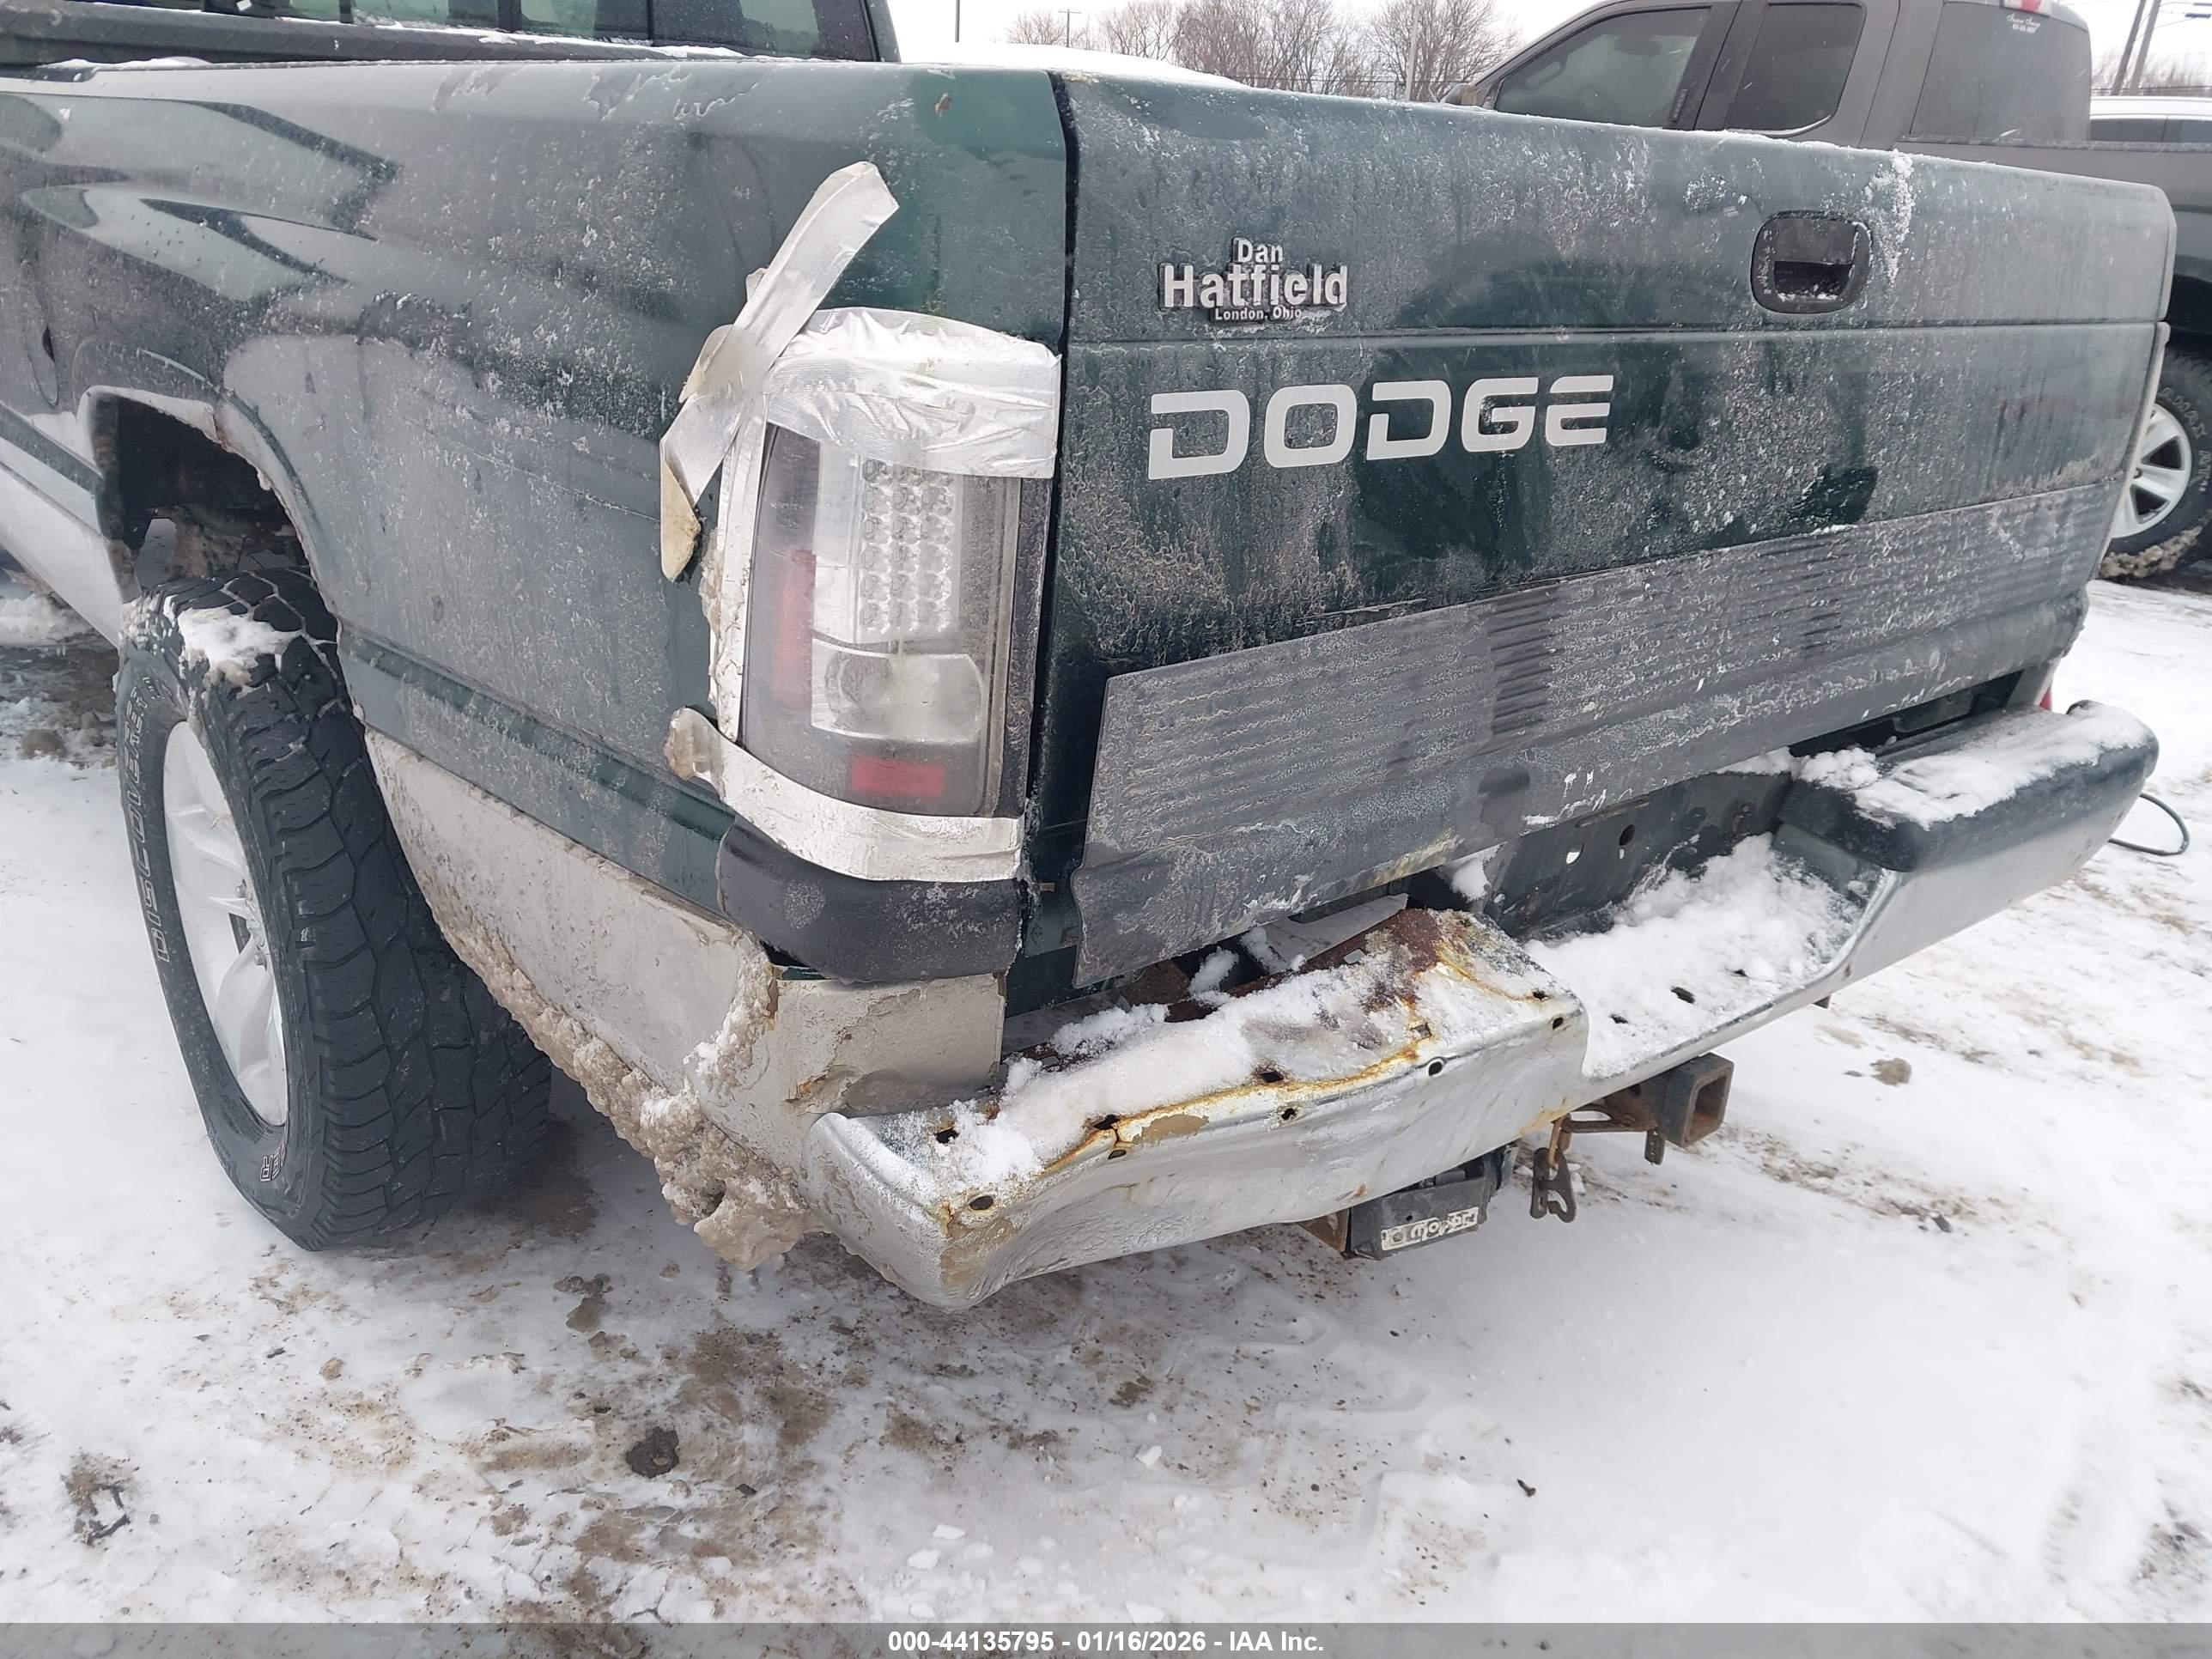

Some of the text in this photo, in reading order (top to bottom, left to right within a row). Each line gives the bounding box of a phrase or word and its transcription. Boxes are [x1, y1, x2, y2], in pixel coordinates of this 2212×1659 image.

[1162, 263, 1348, 307] Hatfield
[1235, 237, 1284, 263] Dan
[1147, 374, 1614, 480] DODGE
[125, 685, 170, 963] DISCOVERER
